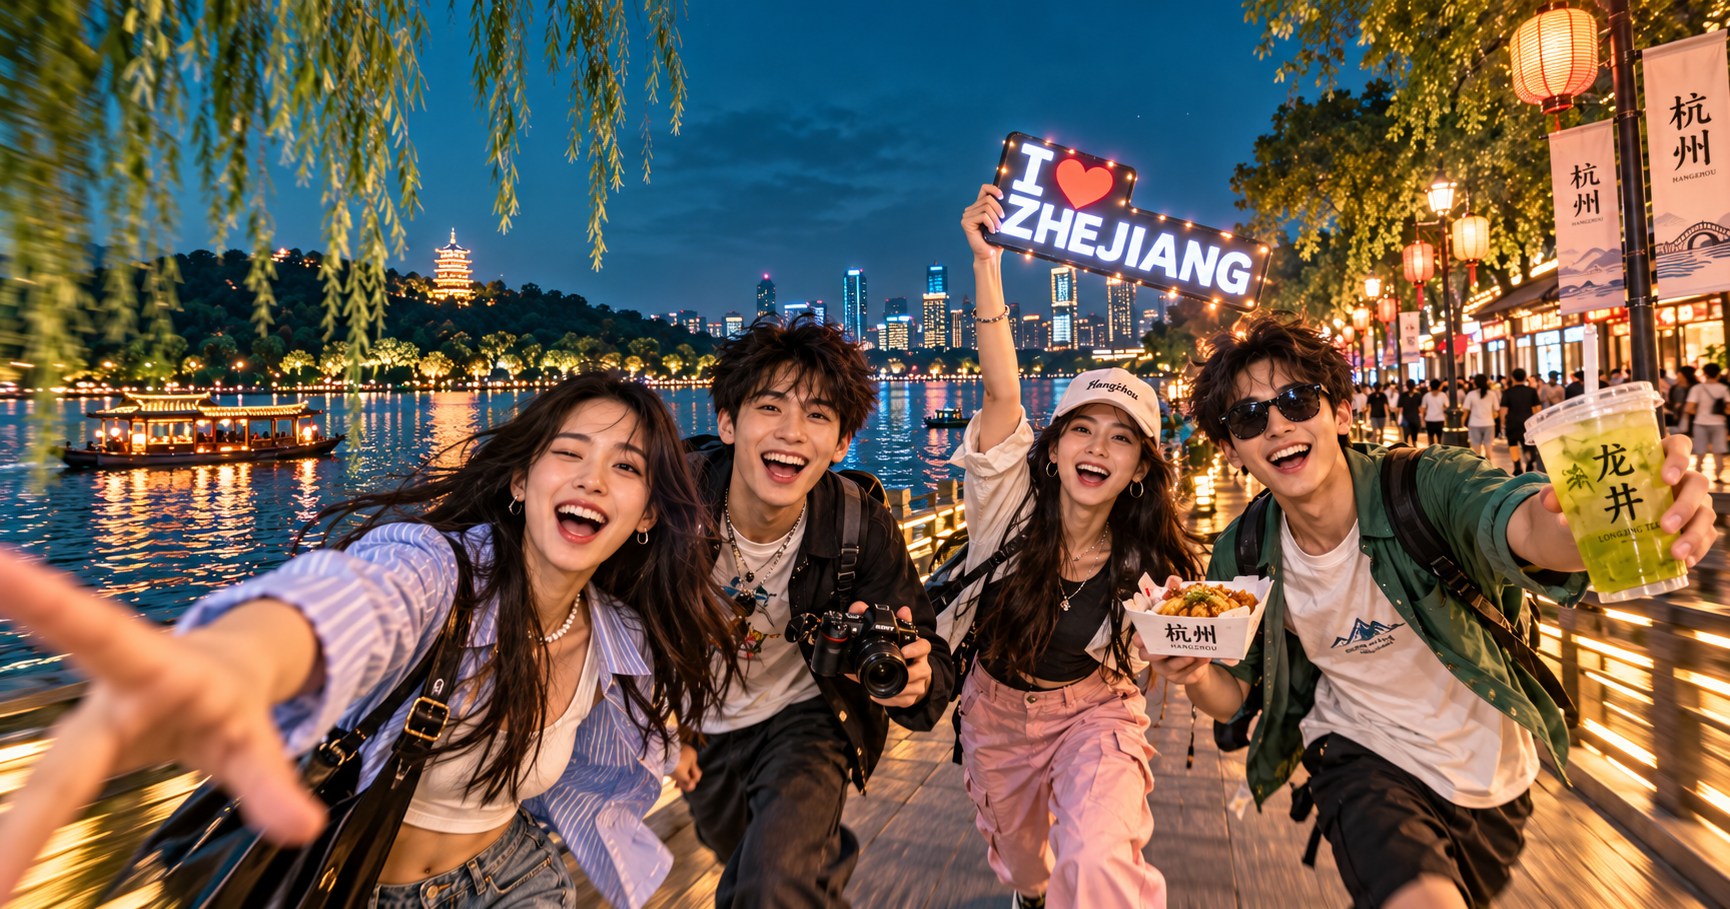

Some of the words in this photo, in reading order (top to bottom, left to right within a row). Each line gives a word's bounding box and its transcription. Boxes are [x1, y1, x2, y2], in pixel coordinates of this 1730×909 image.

[1669, 92, 1712, 171] 杭州
[1012, 142, 1054, 197] I
[1570, 163, 1601, 217] 杭州
[999, 193, 1254, 297] ZHEJIANG
[1592, 443, 1644, 525] 龙井
[1165, 623, 1217, 644] 杭州
